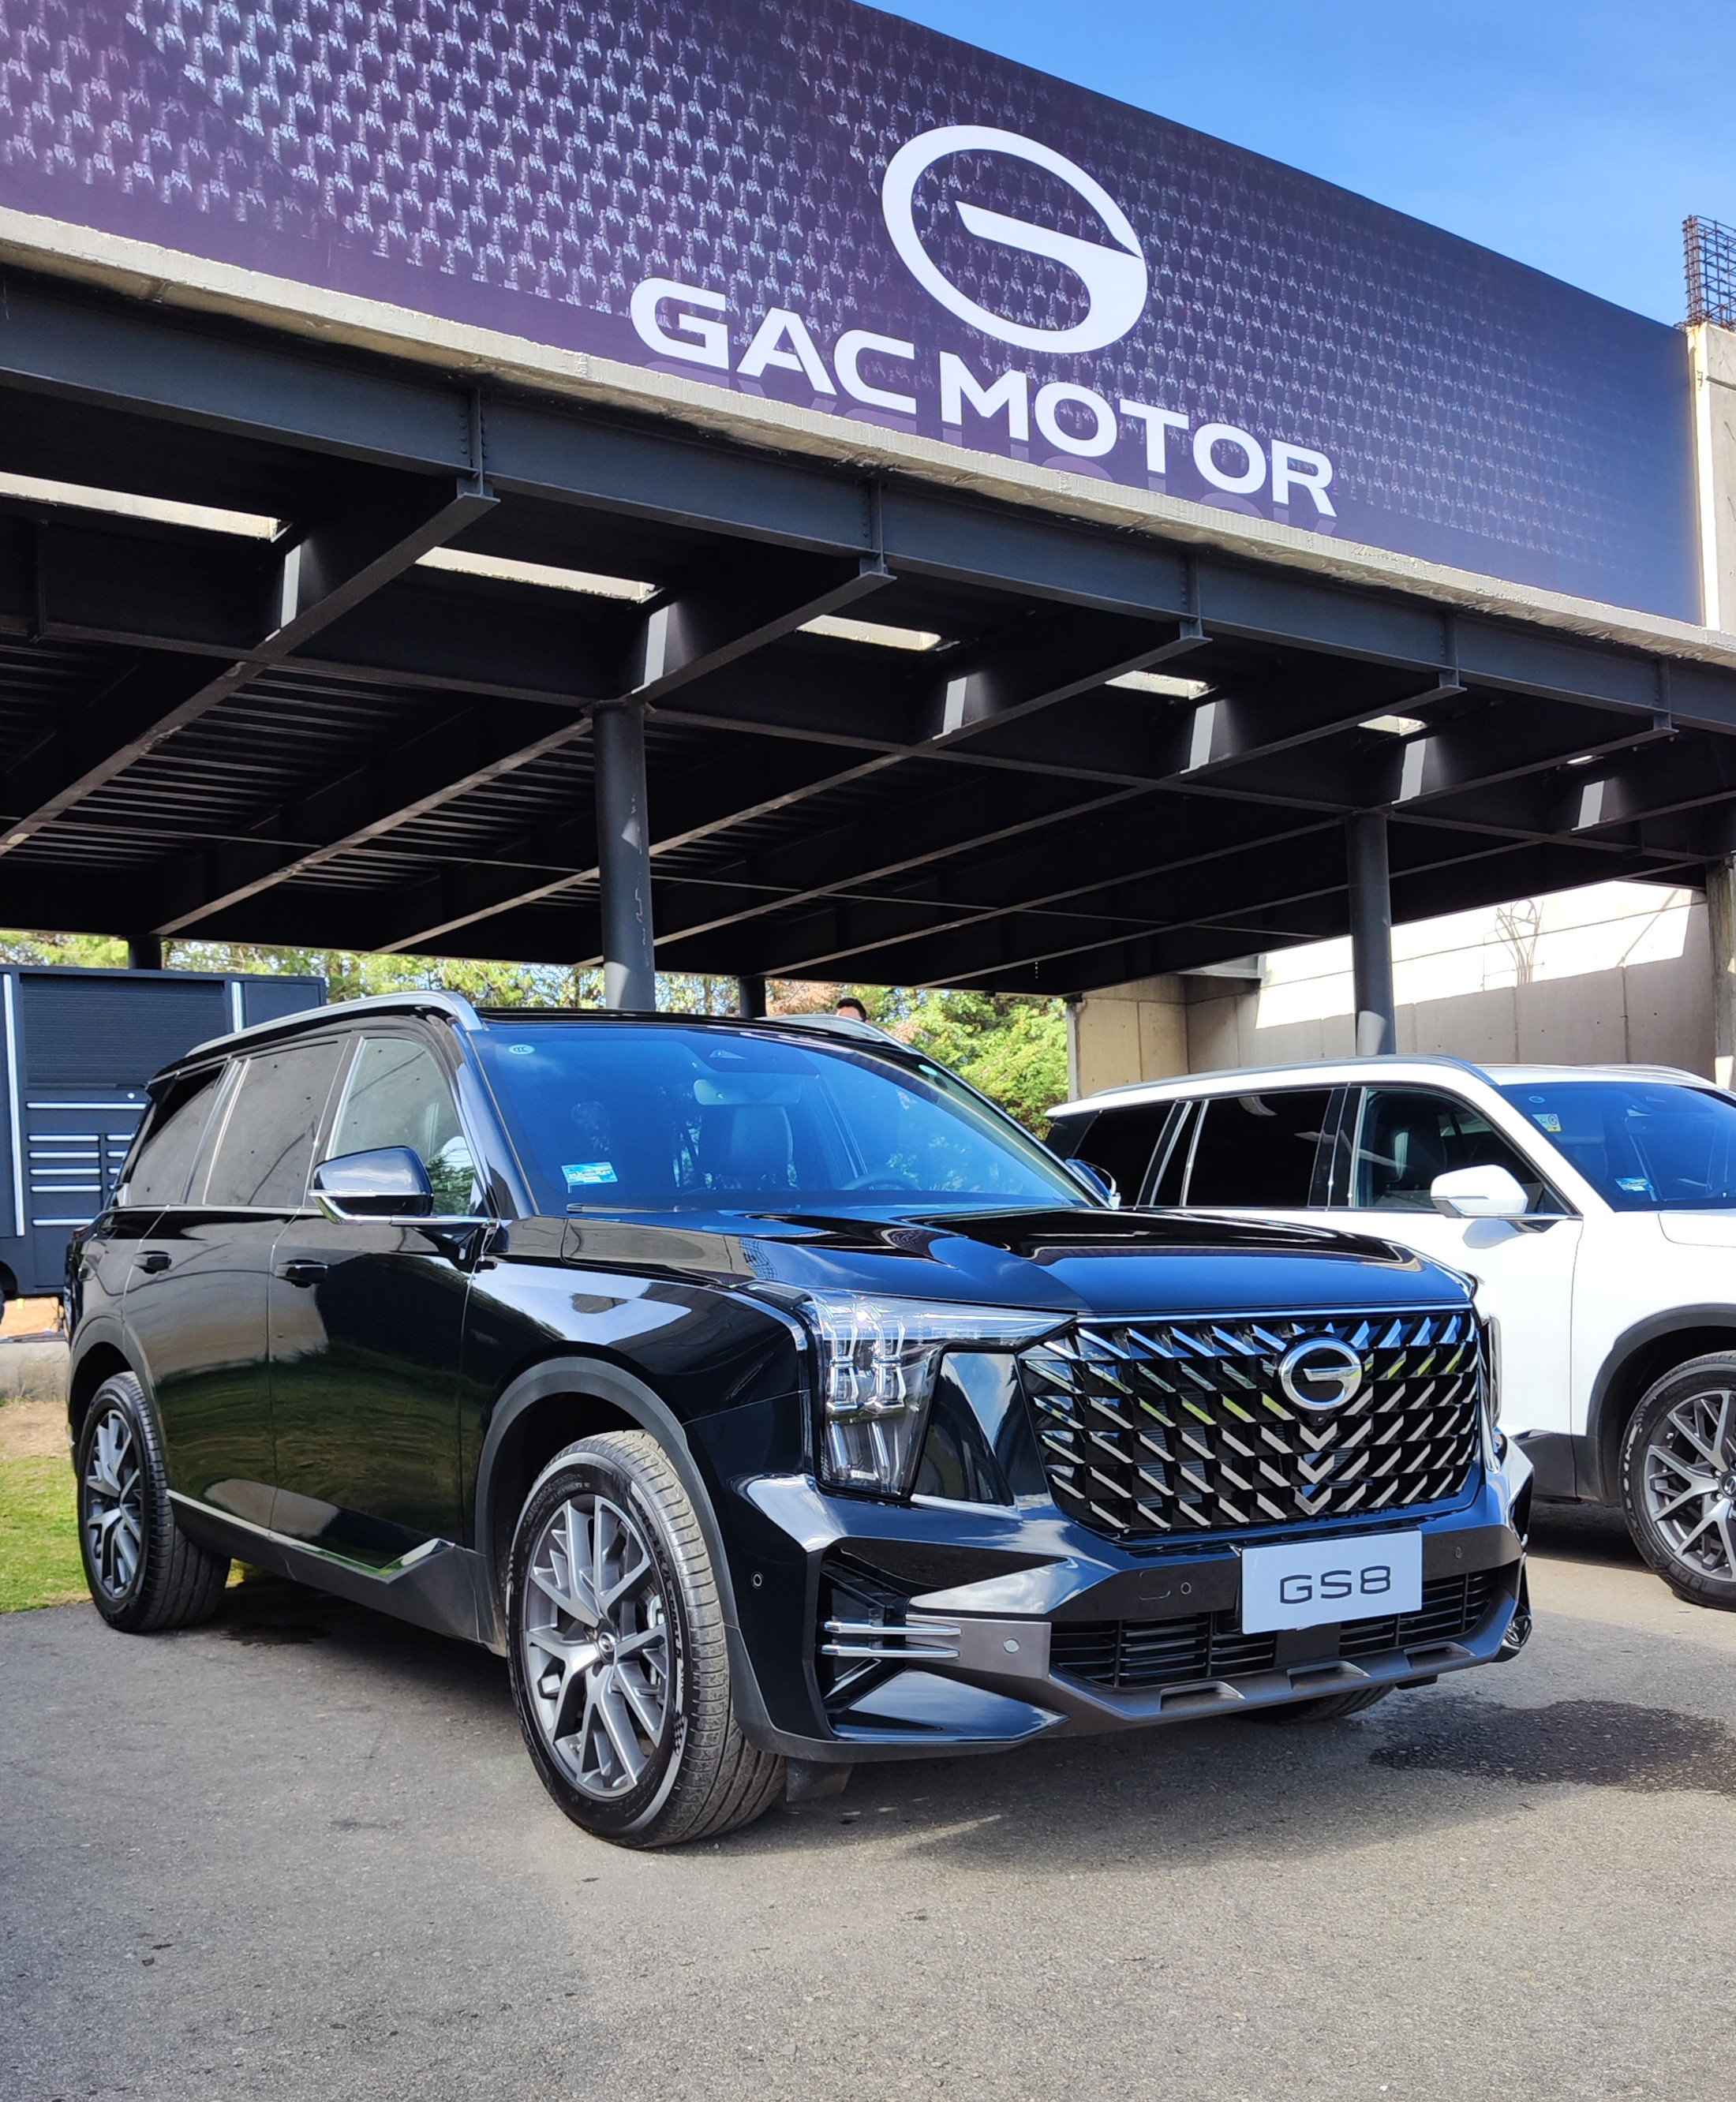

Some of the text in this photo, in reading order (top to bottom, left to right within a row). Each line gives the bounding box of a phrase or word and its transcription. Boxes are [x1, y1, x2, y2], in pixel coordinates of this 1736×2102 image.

[630, 276, 1338, 518] GAC MOTOR
[1280, 1565, 1391, 1604] GS8
